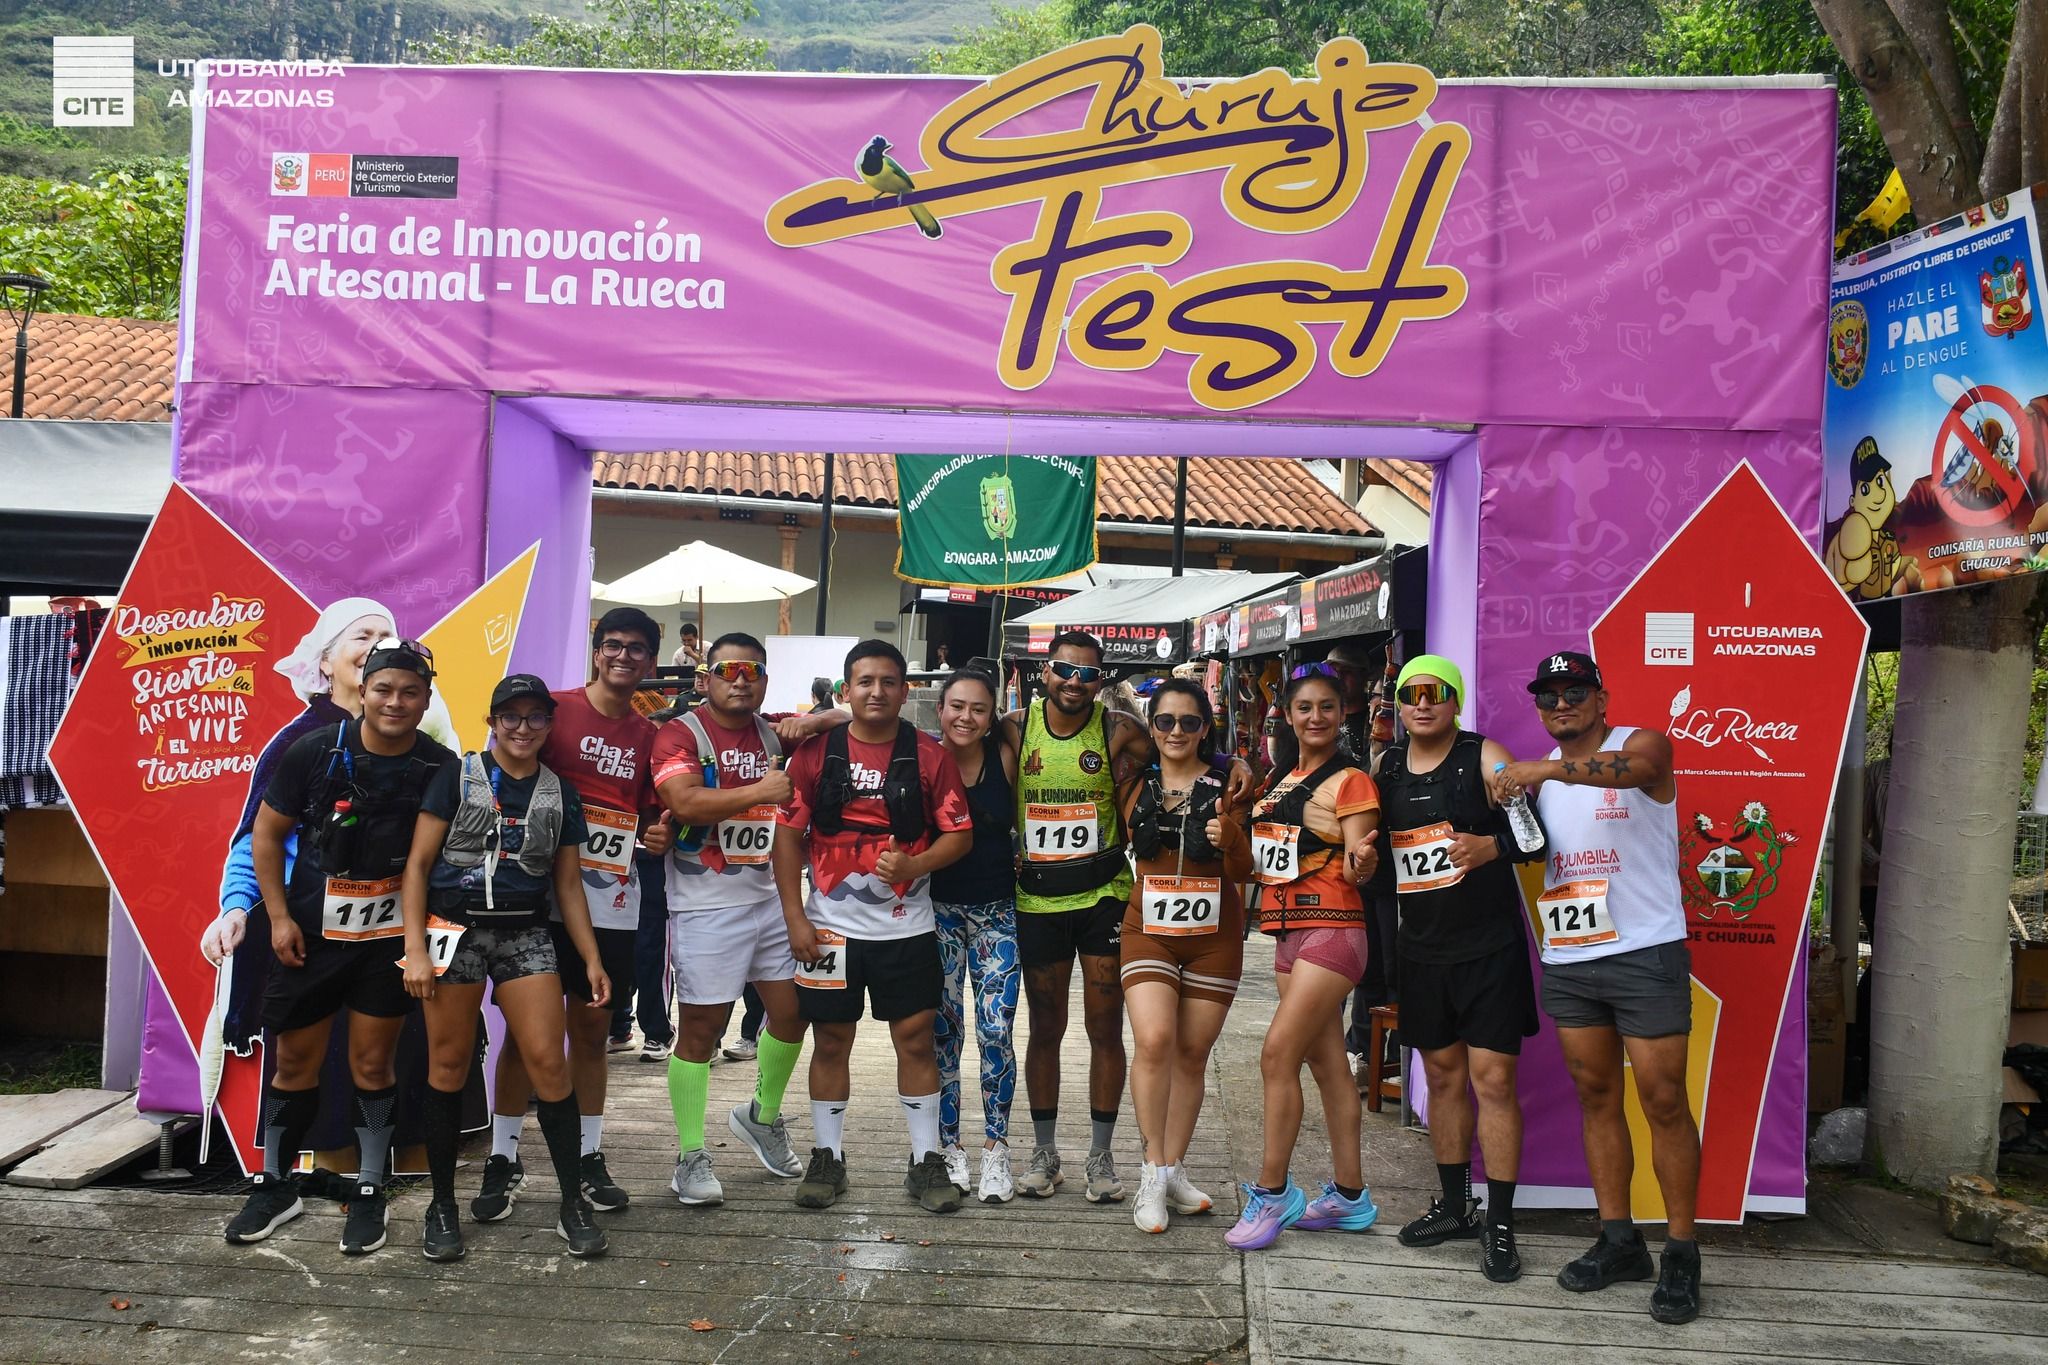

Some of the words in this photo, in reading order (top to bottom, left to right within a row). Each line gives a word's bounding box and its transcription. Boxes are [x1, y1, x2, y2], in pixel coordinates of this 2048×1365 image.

[315, 168, 345, 182] PERÚ
[356, 161, 405, 172] Ministerio
[355, 172, 367, 182] de
[369, 172, 416, 183] Comercio
[417, 173, 455, 184] Exterior
[355, 184, 361, 194] y
[364, 182, 401, 193] Turismo
[266, 212, 377, 254] Feria
[389, 216, 441, 256] de
[453, 217, 701, 263] Innovación
[1011, 141, 1448, 391] Fest
[1880, 260, 1922, 284] DISTRITO
[1924, 249, 1954, 269] LIBRE
[1956, 244, 1970, 259] DE
[264, 258, 486, 302] Artesanal
[525, 266, 578, 305] La
[591, 268, 725, 310] Rueca
[1887, 288, 1935, 313] HAZLE
[1941, 281, 1957, 298] EL
[1888, 305, 1960, 350] PARE
[1881, 361, 1897, 376] AL
[1904, 341, 1969, 369] DENGUE
[907, 454, 975, 513] MUNICIPALIDAD
[1988, 535, 2027, 550] RURAL
[944, 551, 998, 565] BONGARA
[1960, 556, 2011, 572] CHURUJA
[1317, 569, 1382, 603] UTCUBAMBA
[116, 597, 265, 637] Descubre
[1302, 613, 1315, 627] CITE
[1329, 600, 1372, 623] AMAZONAS
[139, 635, 153, 647] LA
[1707, 626, 1823, 638] UTCUBAMBA
[1650, 648, 1688, 659] CITE
[1713, 644, 1816, 656] AMAZONAS
[1550, 655, 1568, 673] LA
[132, 650, 237, 704] Siente
[232, 676, 252, 692] la
[139, 687, 249, 735] ARTESANÍA
[188, 716, 246, 743] VIVE
[1671, 709, 1722, 748] La
[1715, 708, 1799, 743] Rueca
[169, 739, 189, 754] EL
[580, 735, 622, 758] Cha
[580, 753, 599, 762] TEAM
[620, 758, 636, 768] RUN
[720, 748, 756, 766] Cha
[137, 754, 258, 785] Turismo
[596, 757, 635, 780] Cha
[1704, 769, 1733, 777] Colectiva
[1749, 770, 1773, 778] Región
[1041, 788, 1087, 804] RUNNING
[1029, 807, 1060, 815] ECORUN
[1074, 808, 1094, 816] 12KM
[1595, 810, 1630, 821] BONGARÁ
[586, 831, 626, 858] 05
[723, 826, 770, 850] 106
[1035, 825, 1090, 849] 119
[1401, 846, 1451, 877] 122
[1564, 848, 1620, 867] JUMBILLA
[1579, 865, 1609, 876] MARATÓN
[1610, 864, 1622, 874] 21K
[331, 882, 371, 891] ECORUN
[336, 898, 396, 926] 112
[1153, 898, 1212, 922] 120
[1548, 902, 1597, 932] 121
[1687, 931, 1702, 941] DE
[1707, 931, 1776, 945] CHURUJA
